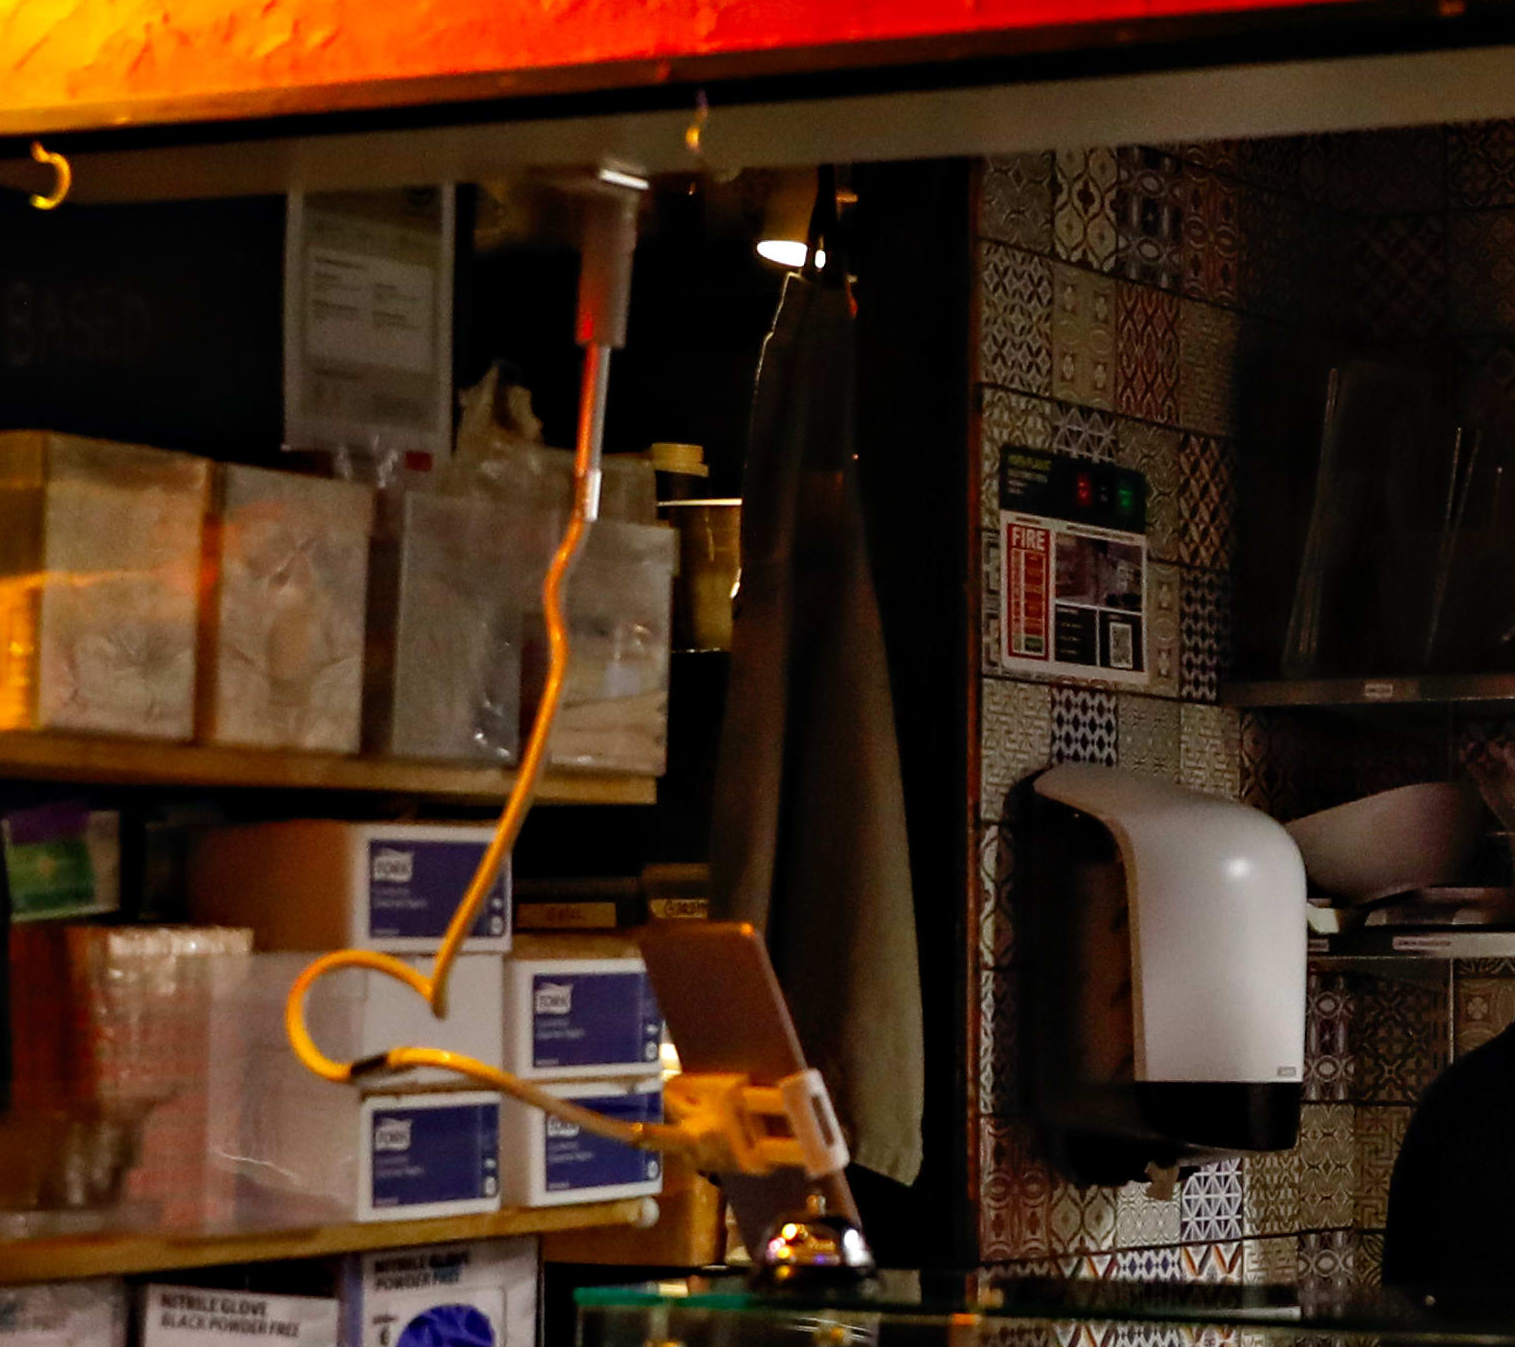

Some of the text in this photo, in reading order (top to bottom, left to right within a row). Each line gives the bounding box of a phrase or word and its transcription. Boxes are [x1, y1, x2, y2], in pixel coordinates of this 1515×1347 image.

[1010, 526, 1048, 552] FIRE
[161, 1292, 268, 1316] NITRILE GLOVE
[161, 1313, 301, 1338] BLACK POWDER FREE
